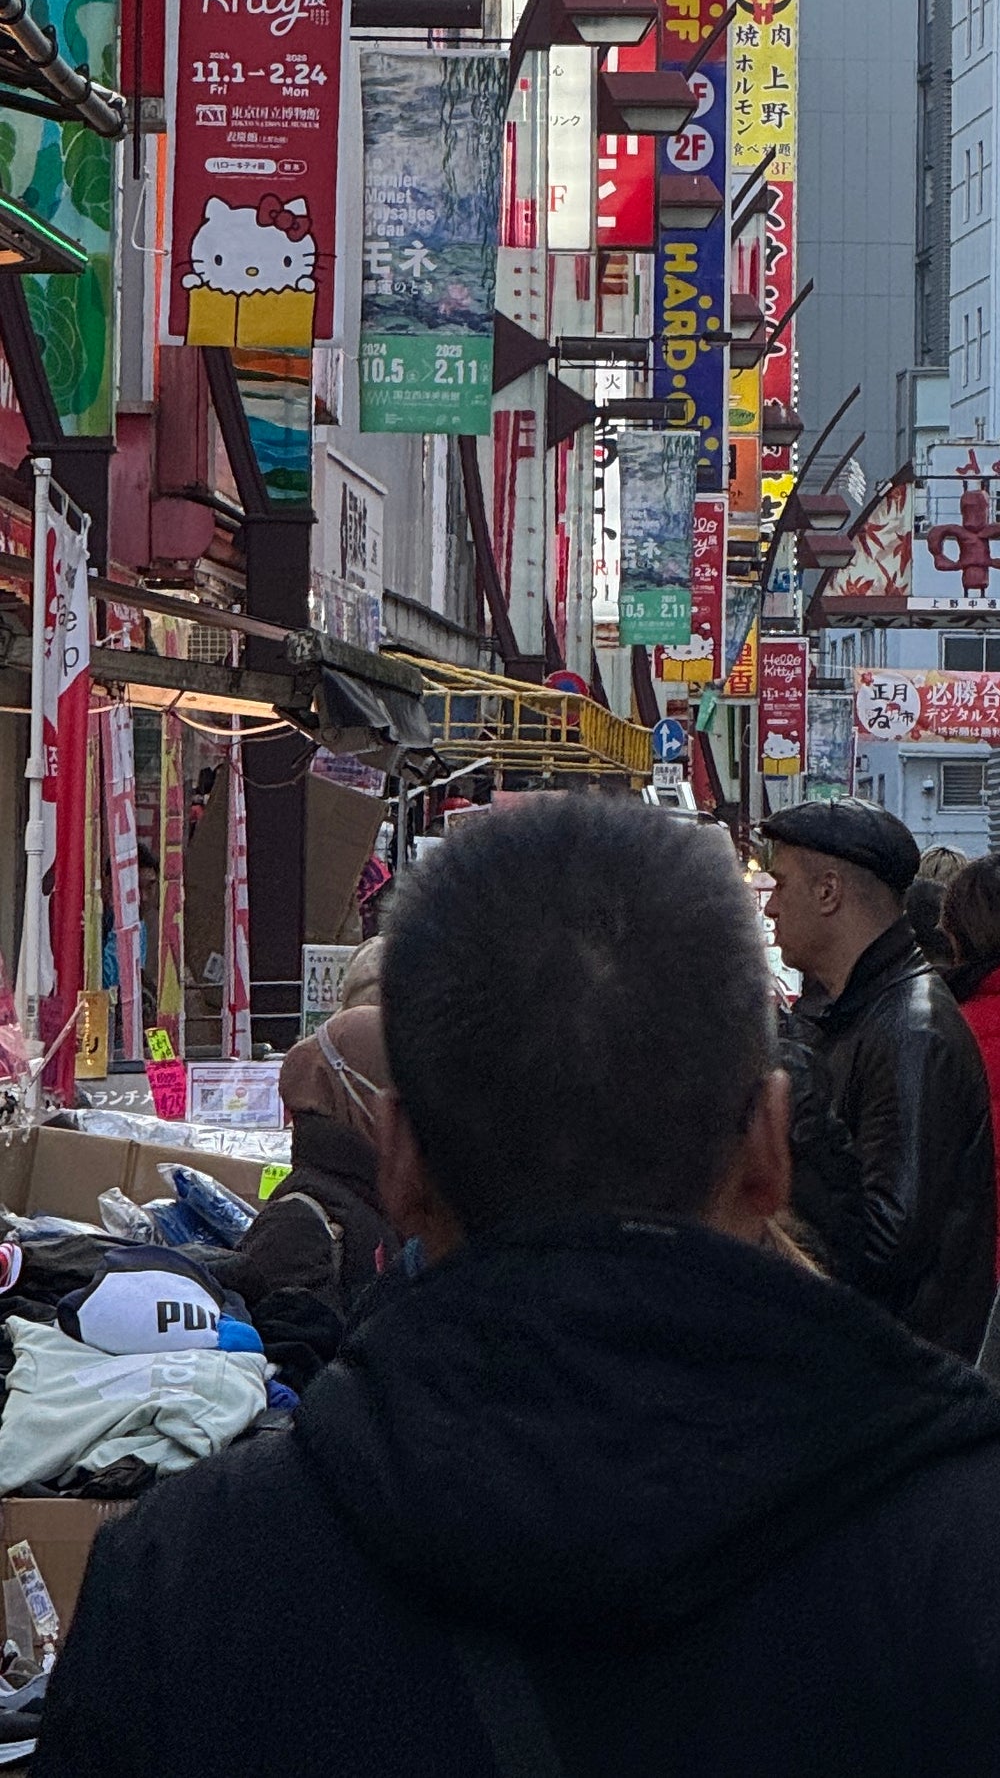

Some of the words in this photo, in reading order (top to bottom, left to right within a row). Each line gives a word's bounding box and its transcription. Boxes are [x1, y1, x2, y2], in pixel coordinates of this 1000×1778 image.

[192, 61, 246, 84] 11.1
[269, 62, 328, 86] 2.24
[209, 84, 228, 95] Fri
[282, 86, 310, 98] Mon
[734, 54, 754, 135] ホルモン
[761, 65, 791, 130] 上野
[674, 133, 707, 161] 2F
[771, 161, 792, 176] 3F
[365, 187, 413, 204] Monet
[365, 203, 436, 224] Paysages
[364, 240, 438, 278] モネ
[361, 343, 387, 356] 2024
[435, 344, 463, 358] 2025
[361, 357, 404, 384] 10.5
[433, 359, 478, 384] 2.11
[622, 538, 662, 559] モネ
[660, 601, 686, 619] 2.11
[762, 653, 802, 667] Hello
[763, 665, 796, 683] Kitty
[869, 682, 908, 703] 正月
